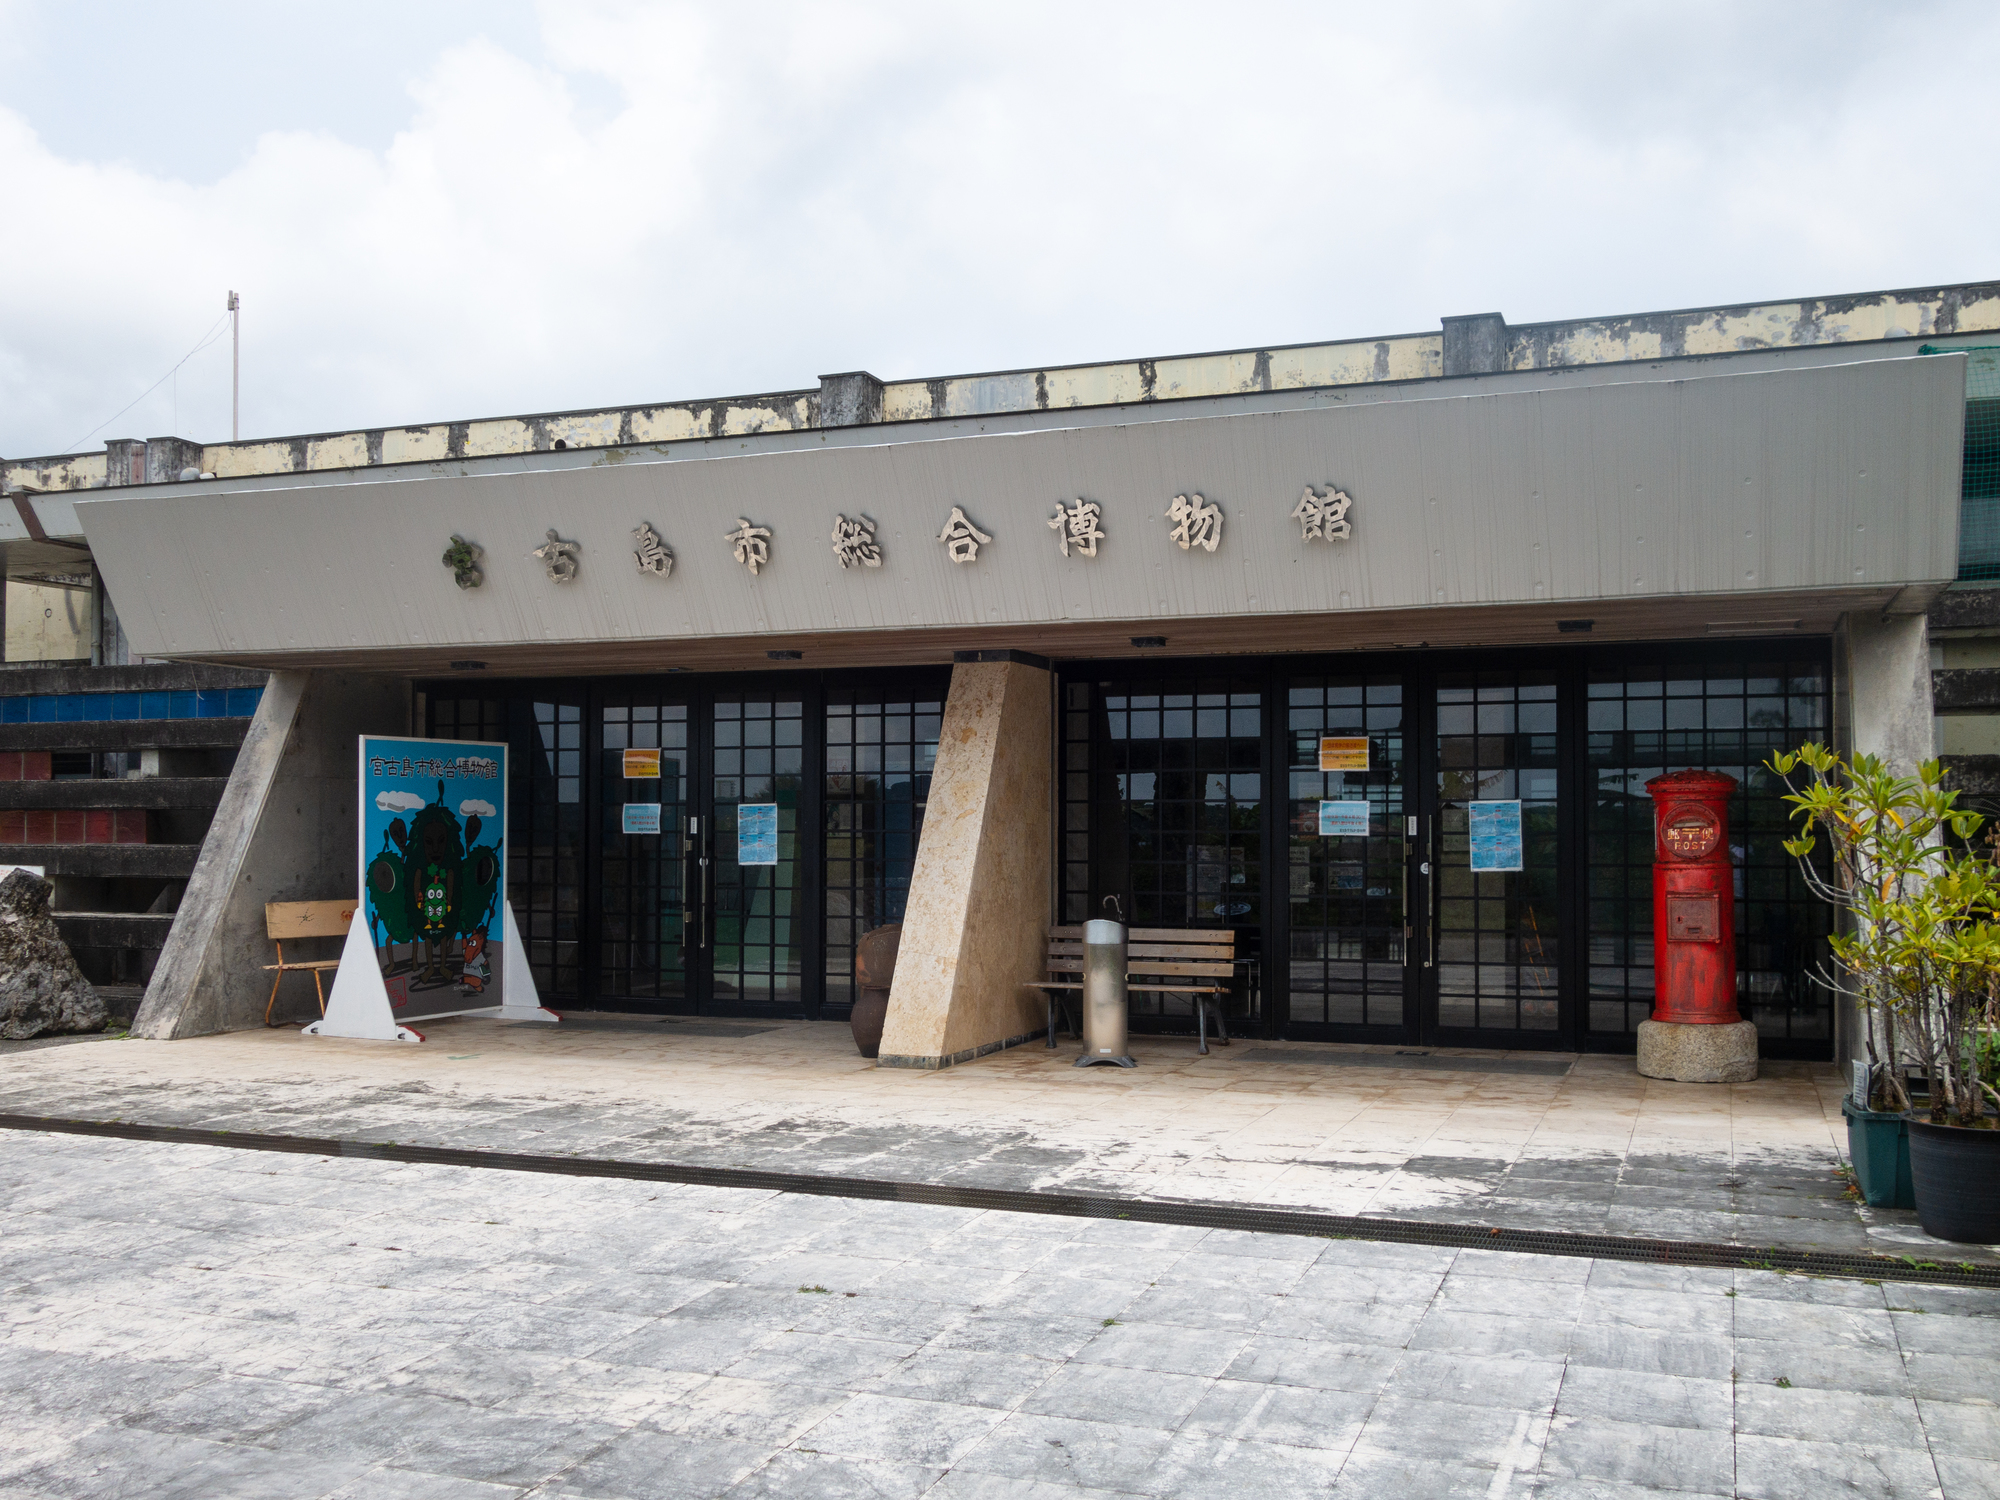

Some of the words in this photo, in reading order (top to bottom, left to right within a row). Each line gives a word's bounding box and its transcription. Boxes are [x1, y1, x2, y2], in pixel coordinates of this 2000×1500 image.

[369, 755, 499, 780] 宮古島市総合博物館
[1674, 841, 1707, 850] POST
